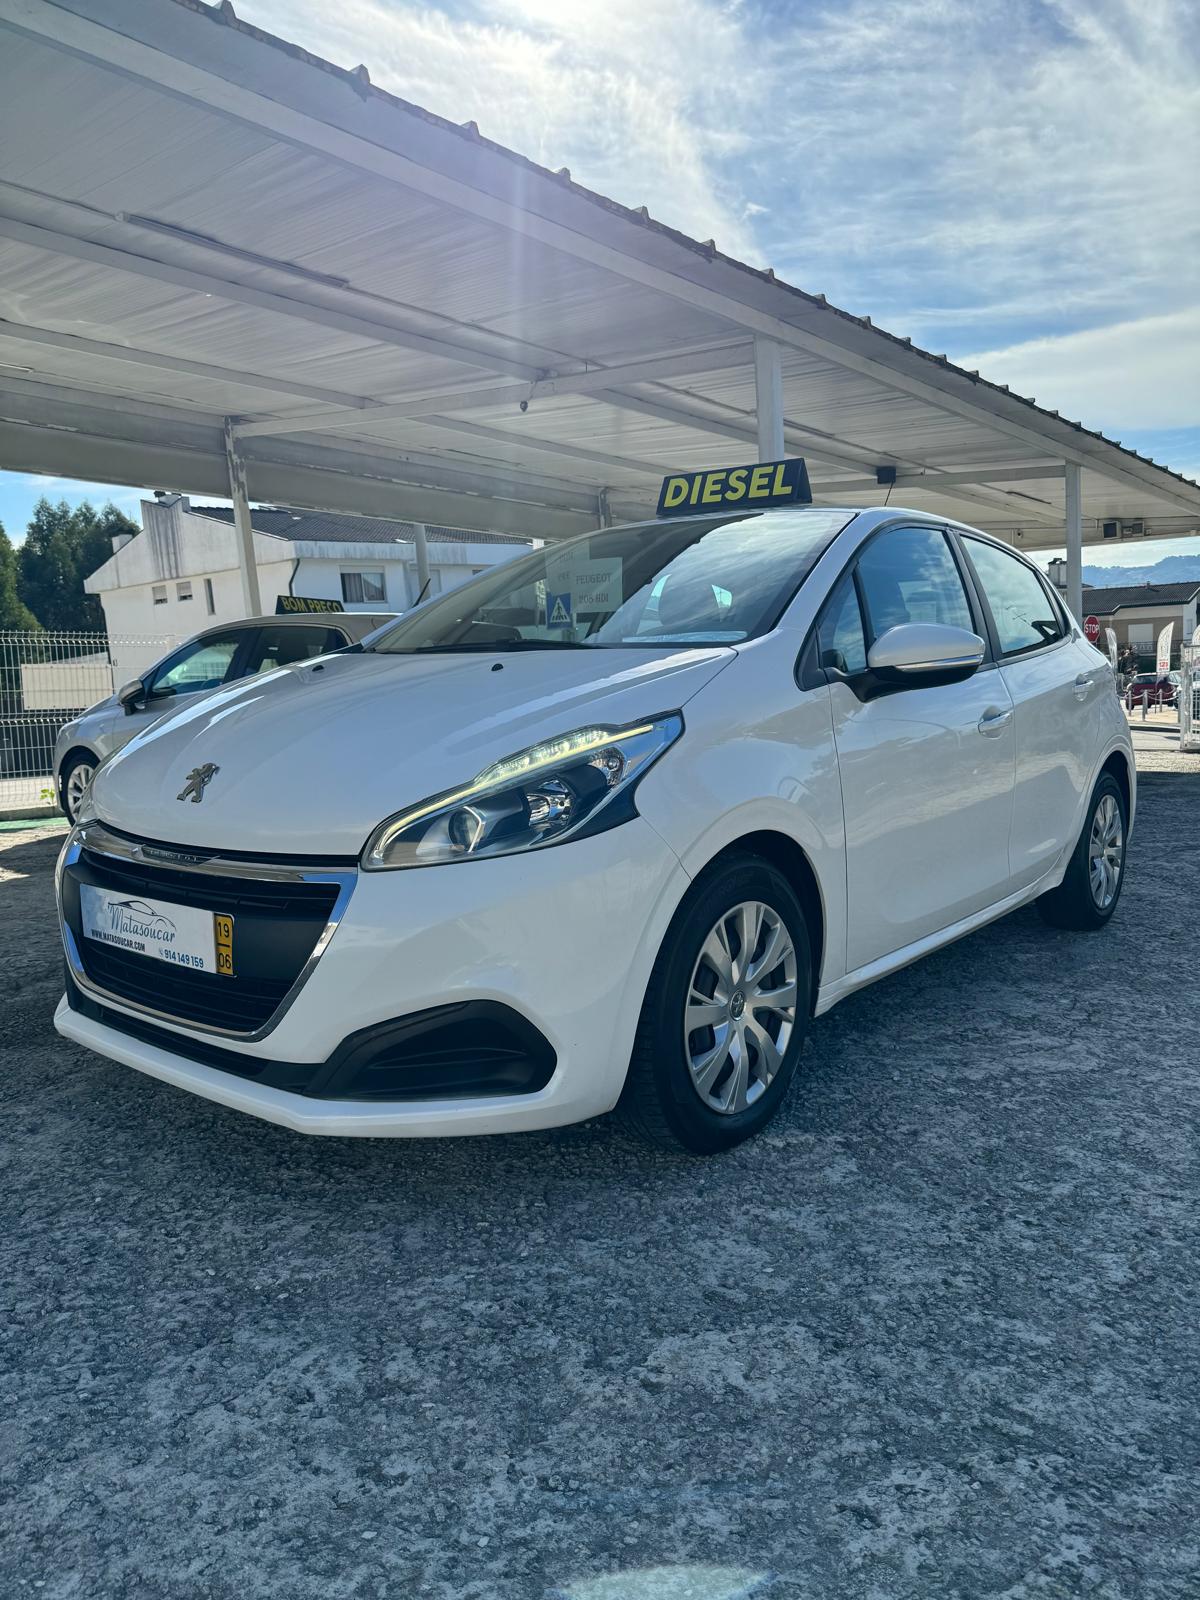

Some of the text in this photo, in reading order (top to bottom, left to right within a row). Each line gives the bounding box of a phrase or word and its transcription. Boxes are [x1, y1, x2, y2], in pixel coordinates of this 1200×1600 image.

[663, 464, 793, 508] DIESEL
[281, 597, 308, 612] BOM
[1084, 623, 1100, 635] STOP
[107, 903, 176, 944] Matasoucar
[217, 921, 230, 938] 19
[164, 949, 204, 969] 914 149 159
[218, 953, 232, 970] 06
